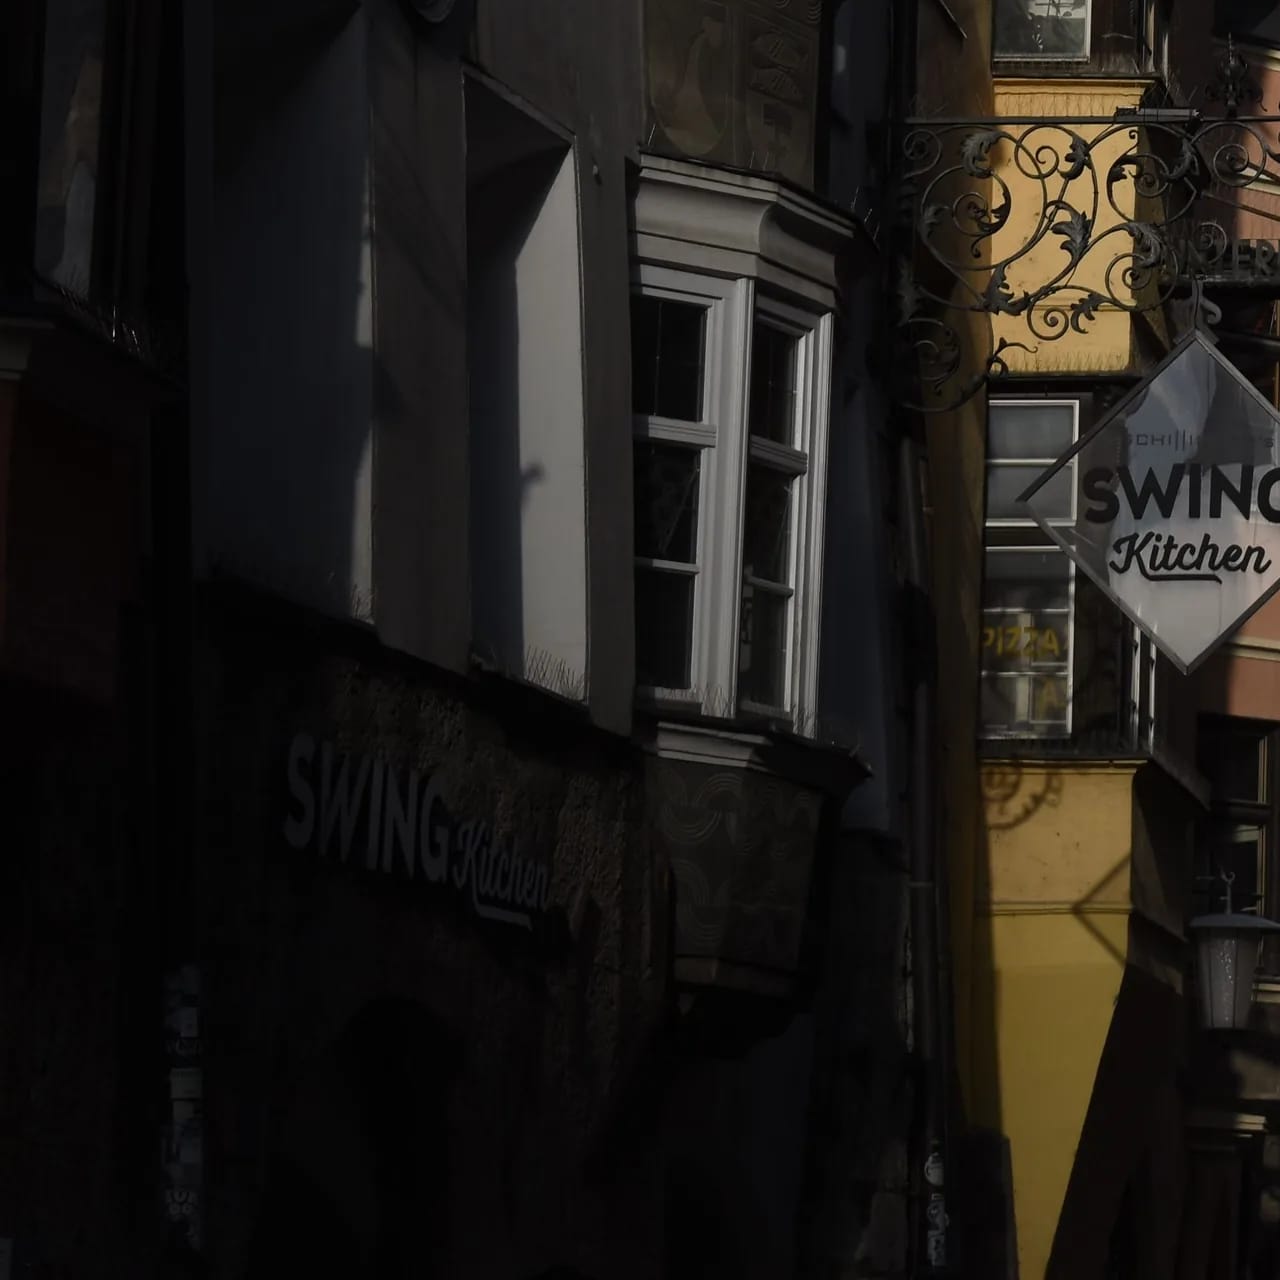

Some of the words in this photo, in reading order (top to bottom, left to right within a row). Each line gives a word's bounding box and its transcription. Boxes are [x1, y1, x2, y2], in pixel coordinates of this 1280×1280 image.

[1109, 531, 1272, 585] Kitchen
[982, 624, 1061, 658] PIZZA
[283, 732, 449, 885] SWING
[453, 819, 550, 933] Kitchen
